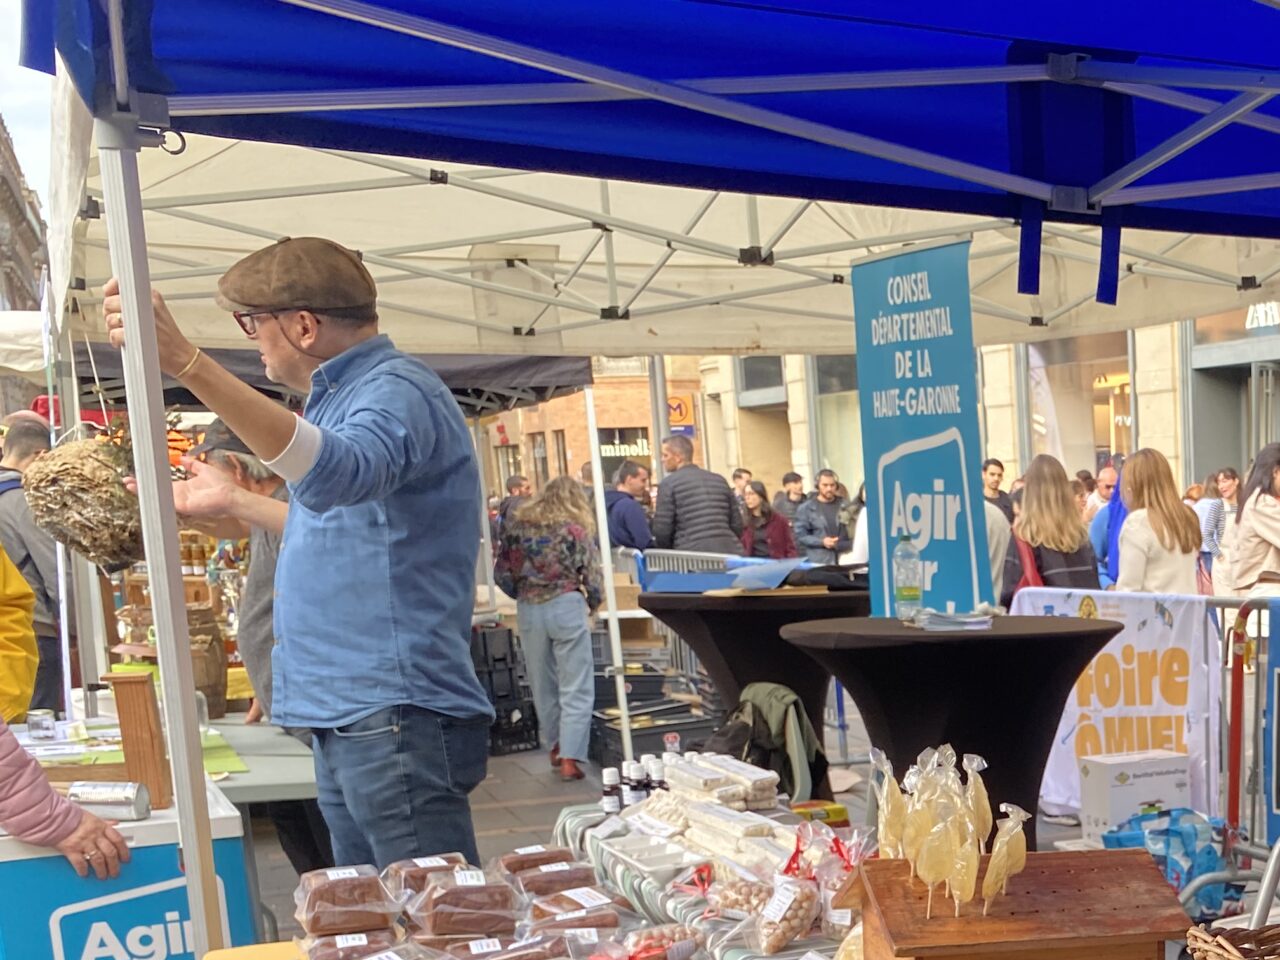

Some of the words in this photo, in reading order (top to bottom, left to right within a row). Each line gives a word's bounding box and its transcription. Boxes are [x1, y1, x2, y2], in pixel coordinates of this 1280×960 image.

[887, 271, 932, 305] CONSEIL
[871, 306, 954, 346] DÉPARTEMENTAL
[895, 350, 913, 379] DE
[917, 349, 932, 378] LA
[873, 384, 961, 418] HAUTE-GARONNE
[890, 478, 962, 552] Agir
